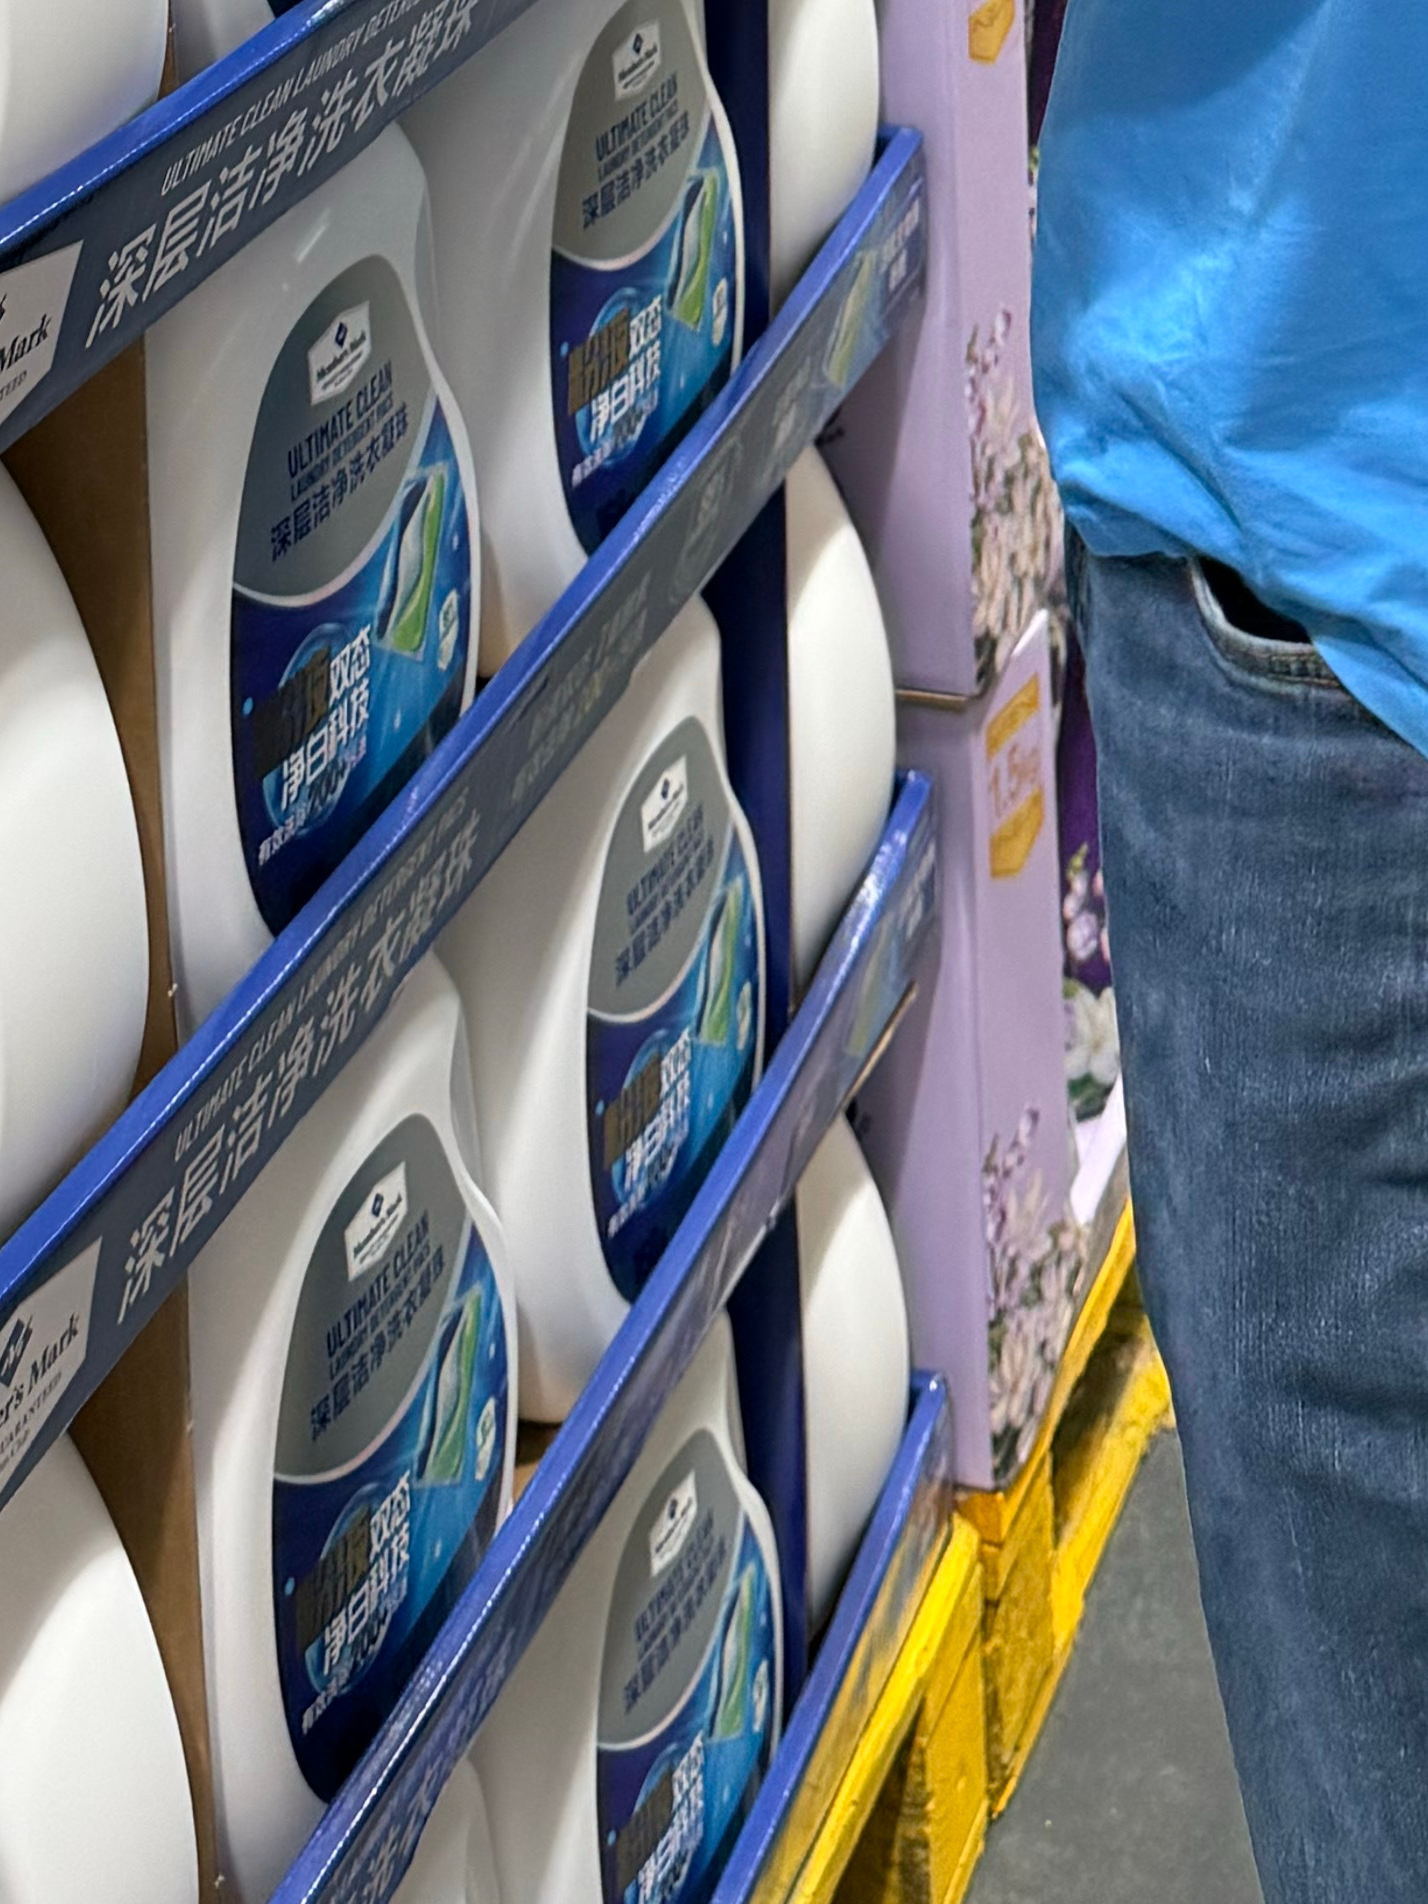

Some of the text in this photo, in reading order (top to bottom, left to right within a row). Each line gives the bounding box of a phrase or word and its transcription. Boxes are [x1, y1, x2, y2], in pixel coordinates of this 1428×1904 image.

[161, 115, 241, 196] ULTIMATE
[239, 79, 292, 136] CLEAN
[290, 25, 363, 93] LAUNDRY
[287, 360, 392, 479] ULTIMATE CLEAN
[26, 1311, 80, 1392] Mark
[326, 1271, 391, 1358] ULTIMATE
